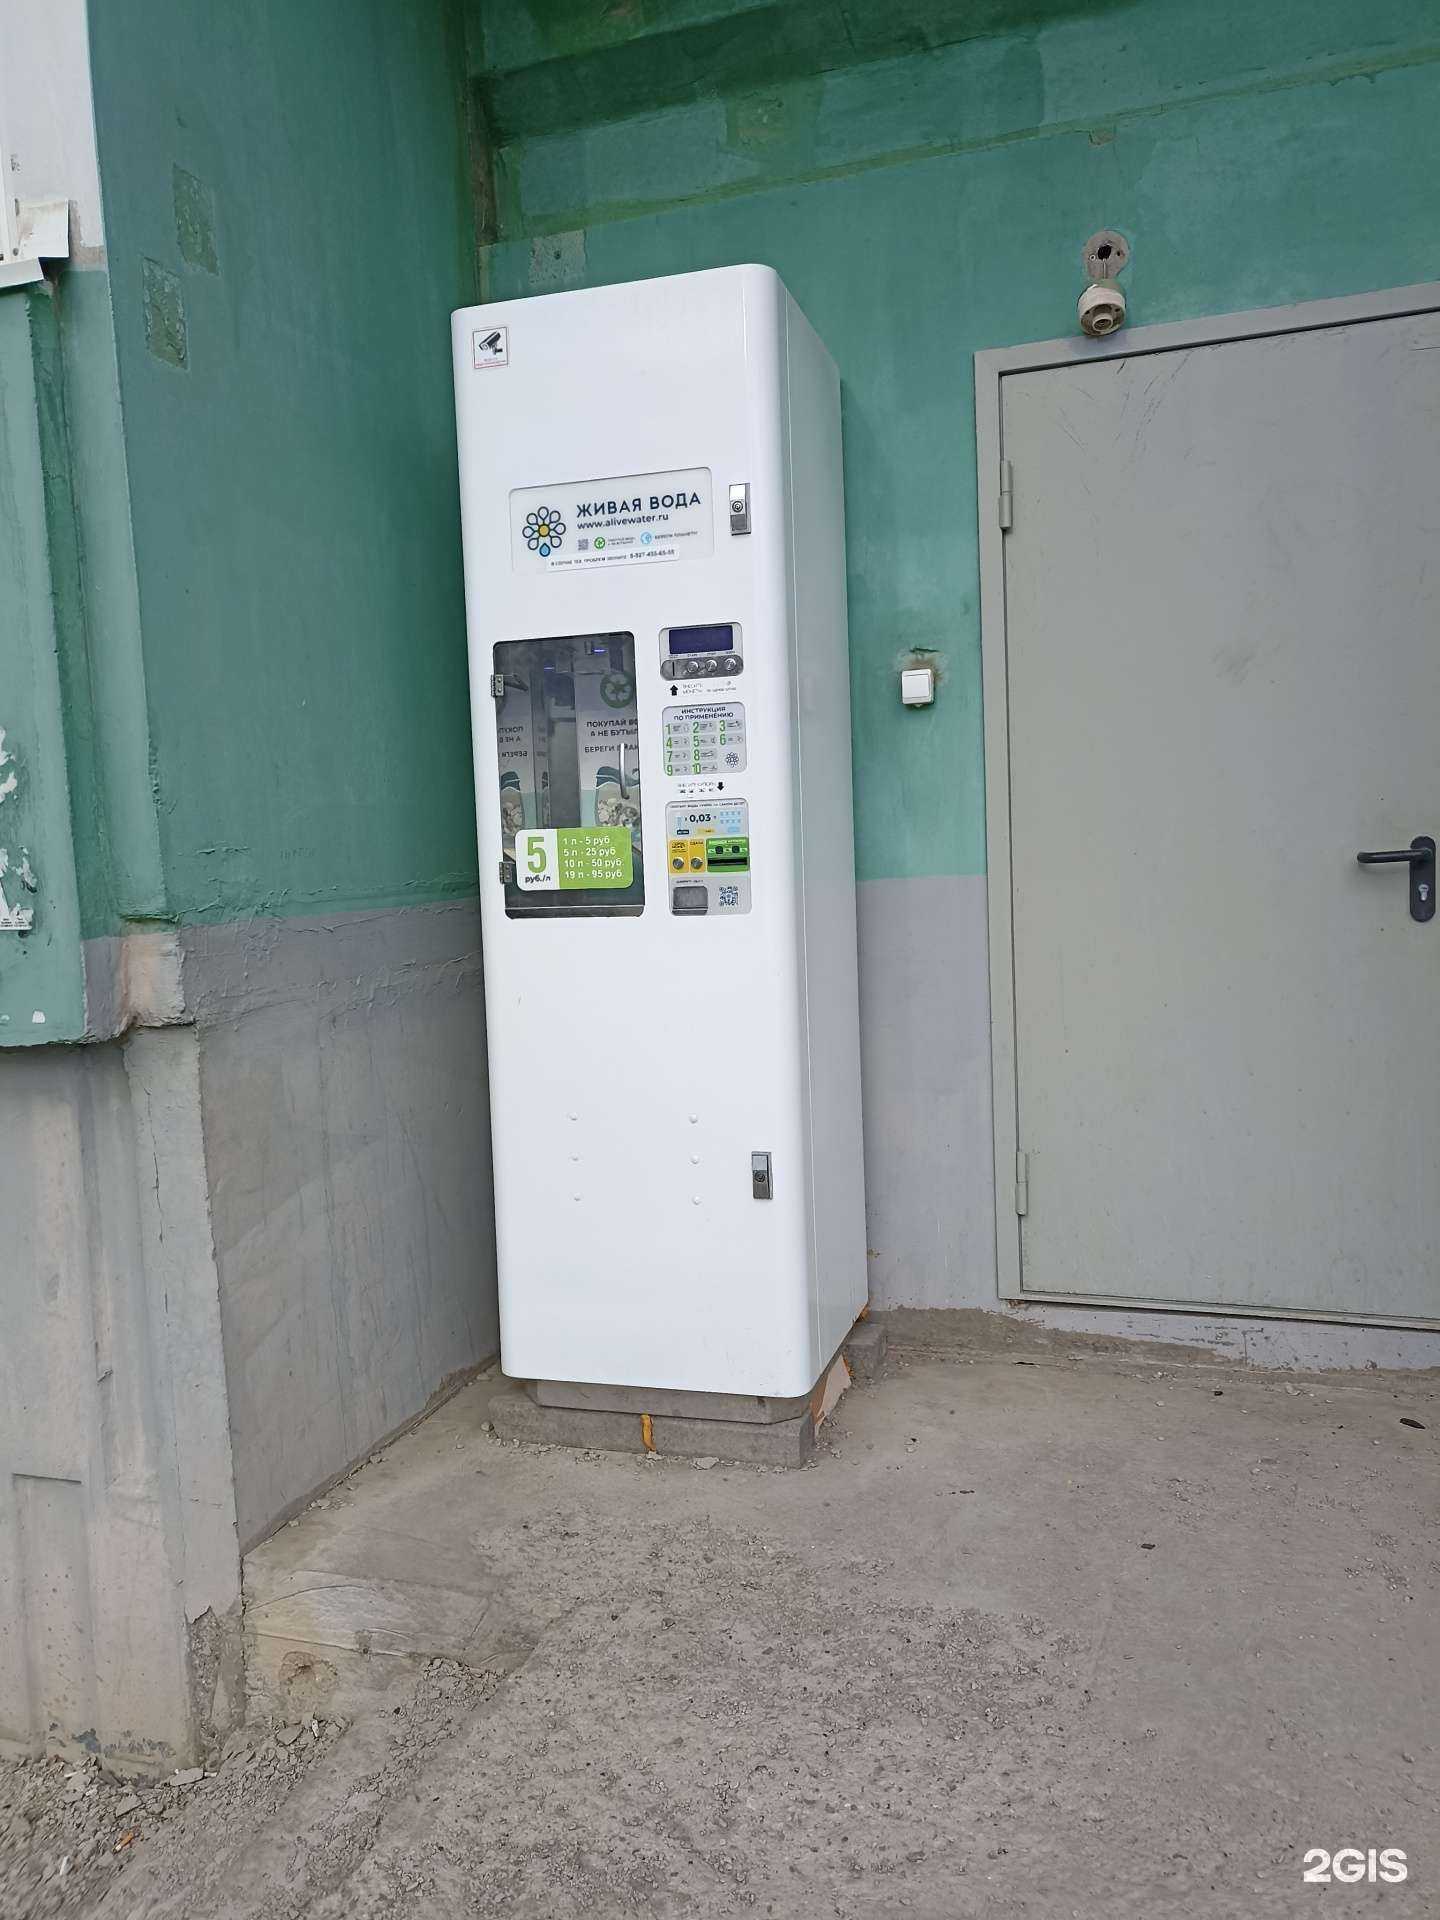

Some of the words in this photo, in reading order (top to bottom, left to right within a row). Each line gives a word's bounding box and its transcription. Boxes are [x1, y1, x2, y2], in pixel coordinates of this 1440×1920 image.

[576, 498, 642, 518] ЖИВАЯ
[650, 492, 701, 510] ВОДА
[577, 513, 669, 530] www.alivewater.ru
[685, 712, 734, 720] ПРИМЕНЕНИЮ
[587, 719, 626, 727] ПОКУПАЙ
[665, 723, 671, 735] 1
[692, 721, 699, 734] 2
[719, 720, 726, 732] 3
[666, 737, 673, 749] 4
[693, 735, 700, 748] 5
[720, 733, 726, 746] 6
[666, 750, 673, 763] 7
[693, 749, 700, 761] 8
[666, 764, 673, 776] 9
[692, 762, 701, 775] 10
[689, 813, 711, 823] 0,03
[527, 836, 546, 873] 5
[586, 848, 596, 856] 25
[591, 859, 602, 867] 50
[565, 871, 575, 879] 19
[591, 870, 602, 878] 95
